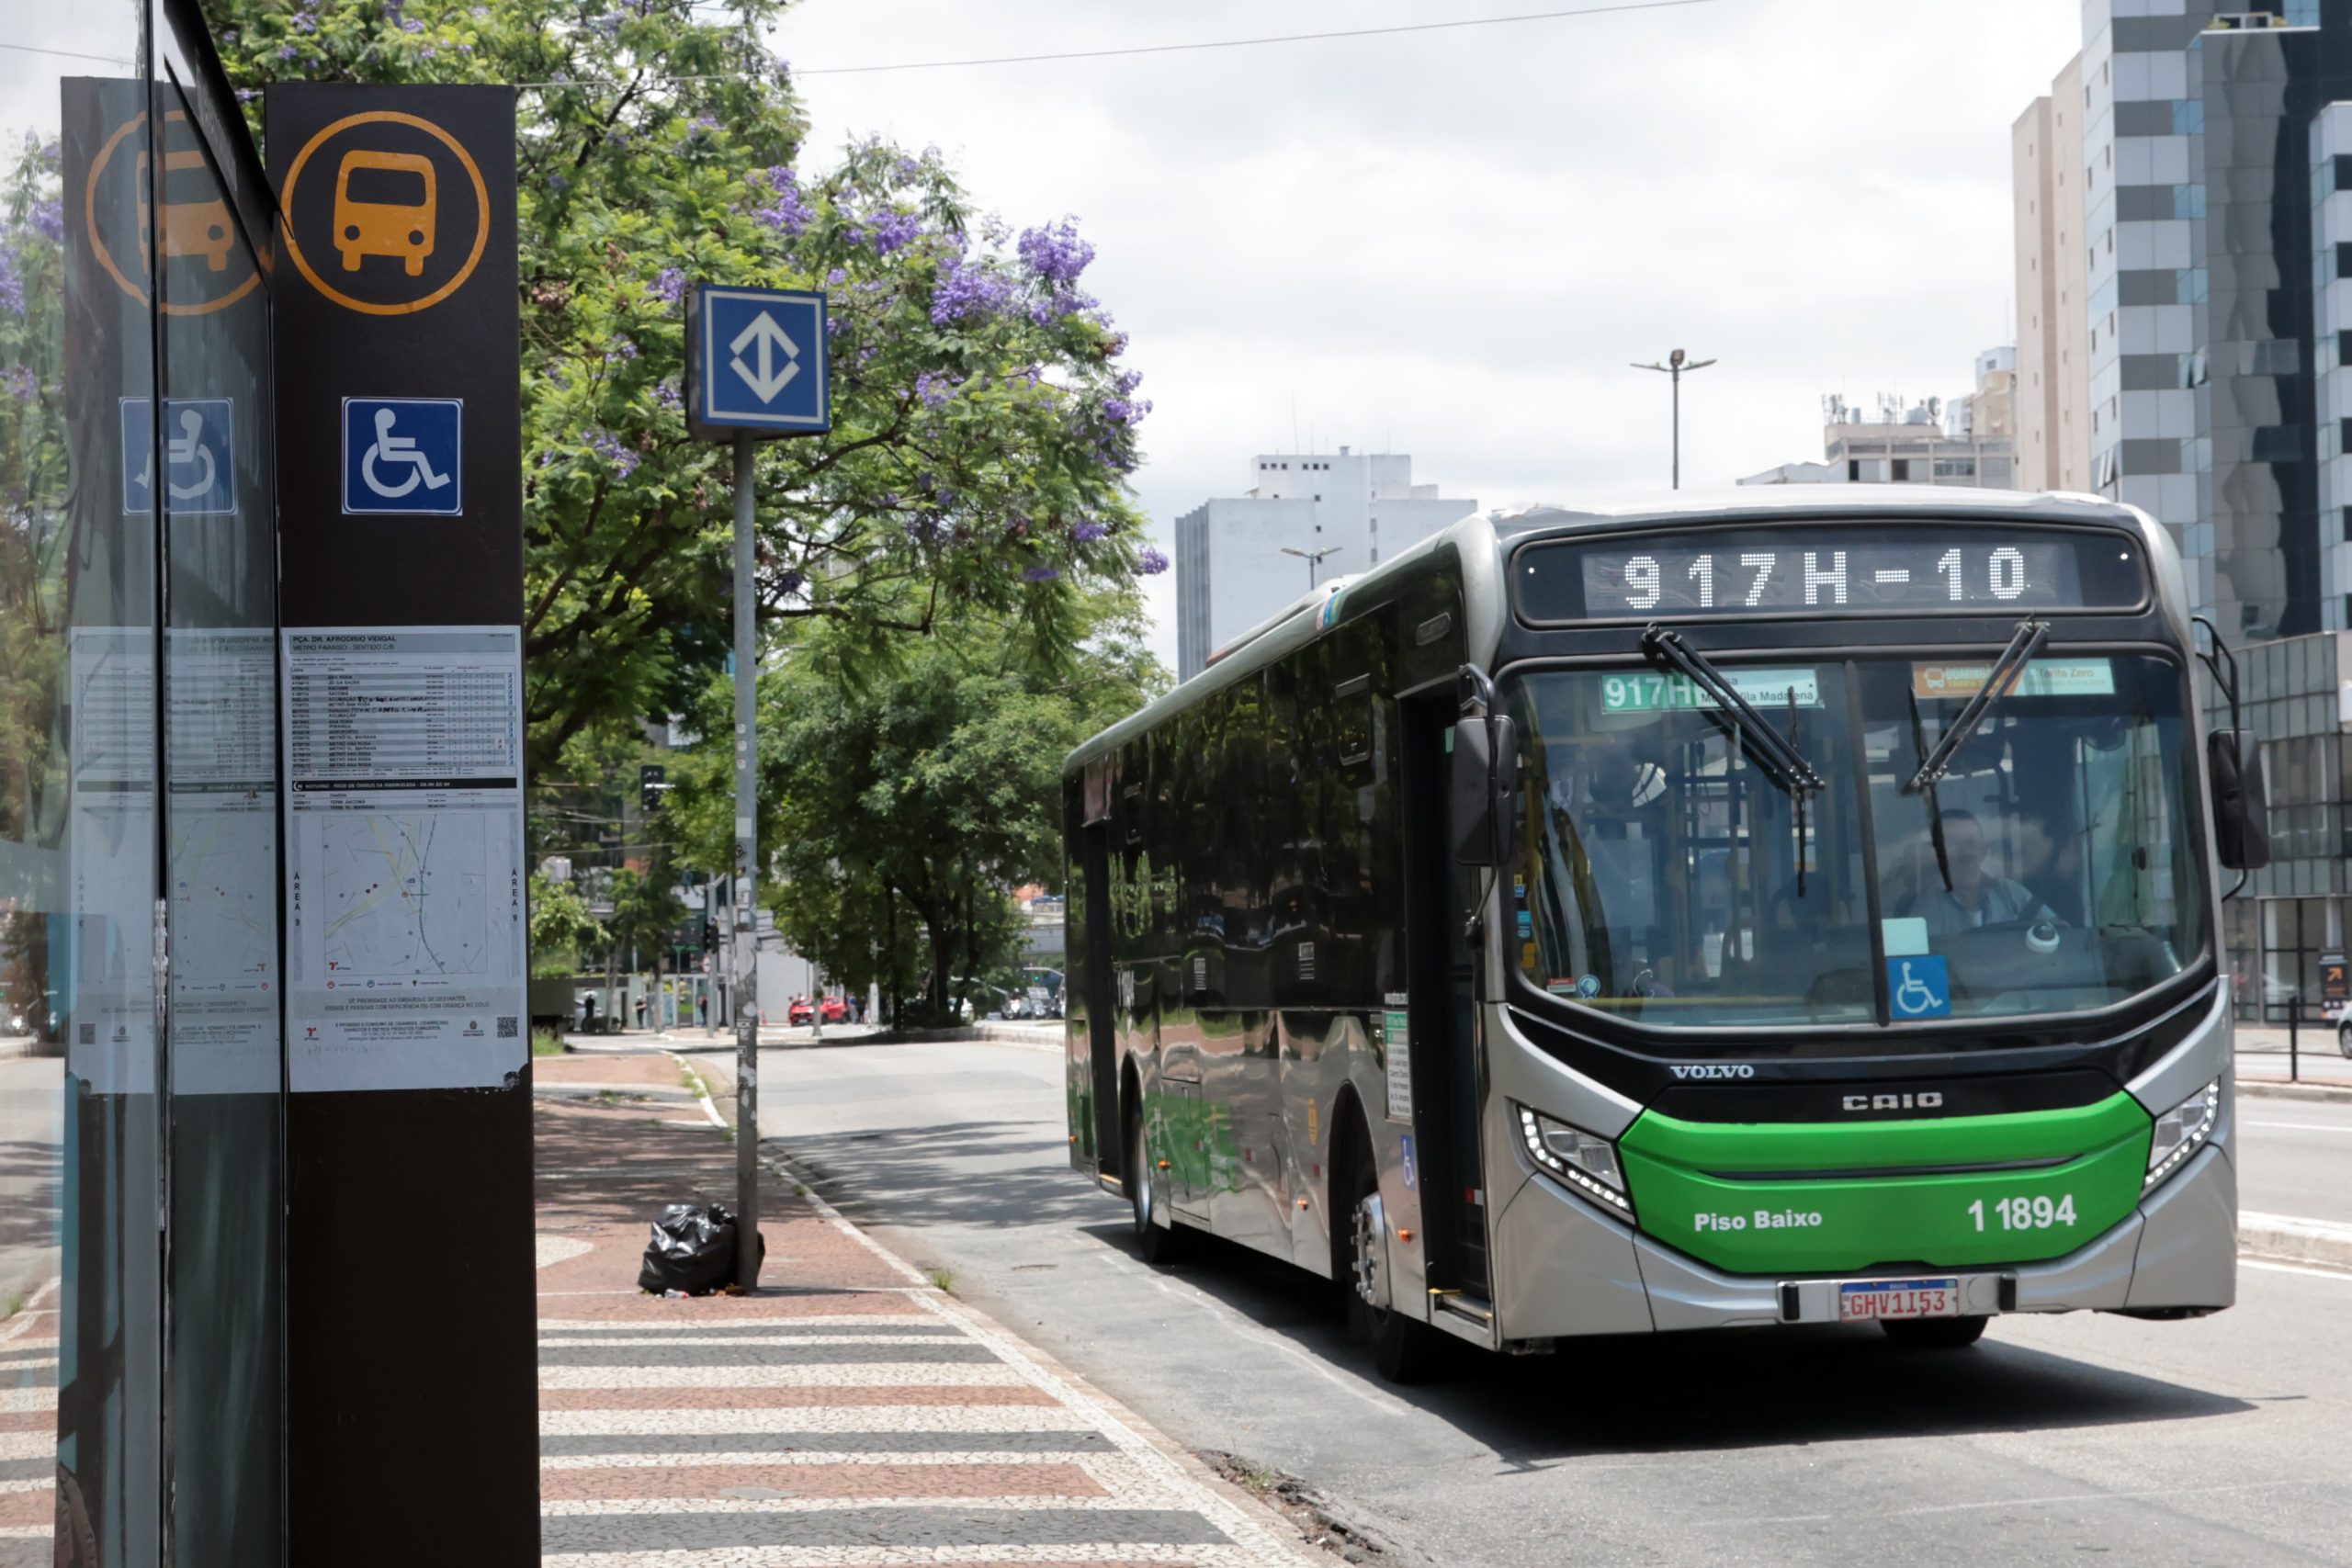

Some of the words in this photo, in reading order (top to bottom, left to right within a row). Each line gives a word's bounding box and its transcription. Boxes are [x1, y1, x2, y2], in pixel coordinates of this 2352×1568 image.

[1605, 675, 1691, 706] 917H
[1759, 691, 1814, 701] Madaena
[513, 914, 518, 922] 9
[1670, 1065, 1755, 1079] VOLVO
[1842, 1091, 1944, 1112] CAIO
[1694, 1213, 1747, 1233] Piso
[1754, 1209, 1823, 1229] Baixo
[1851, 1291, 1946, 1315] GHV1I53
